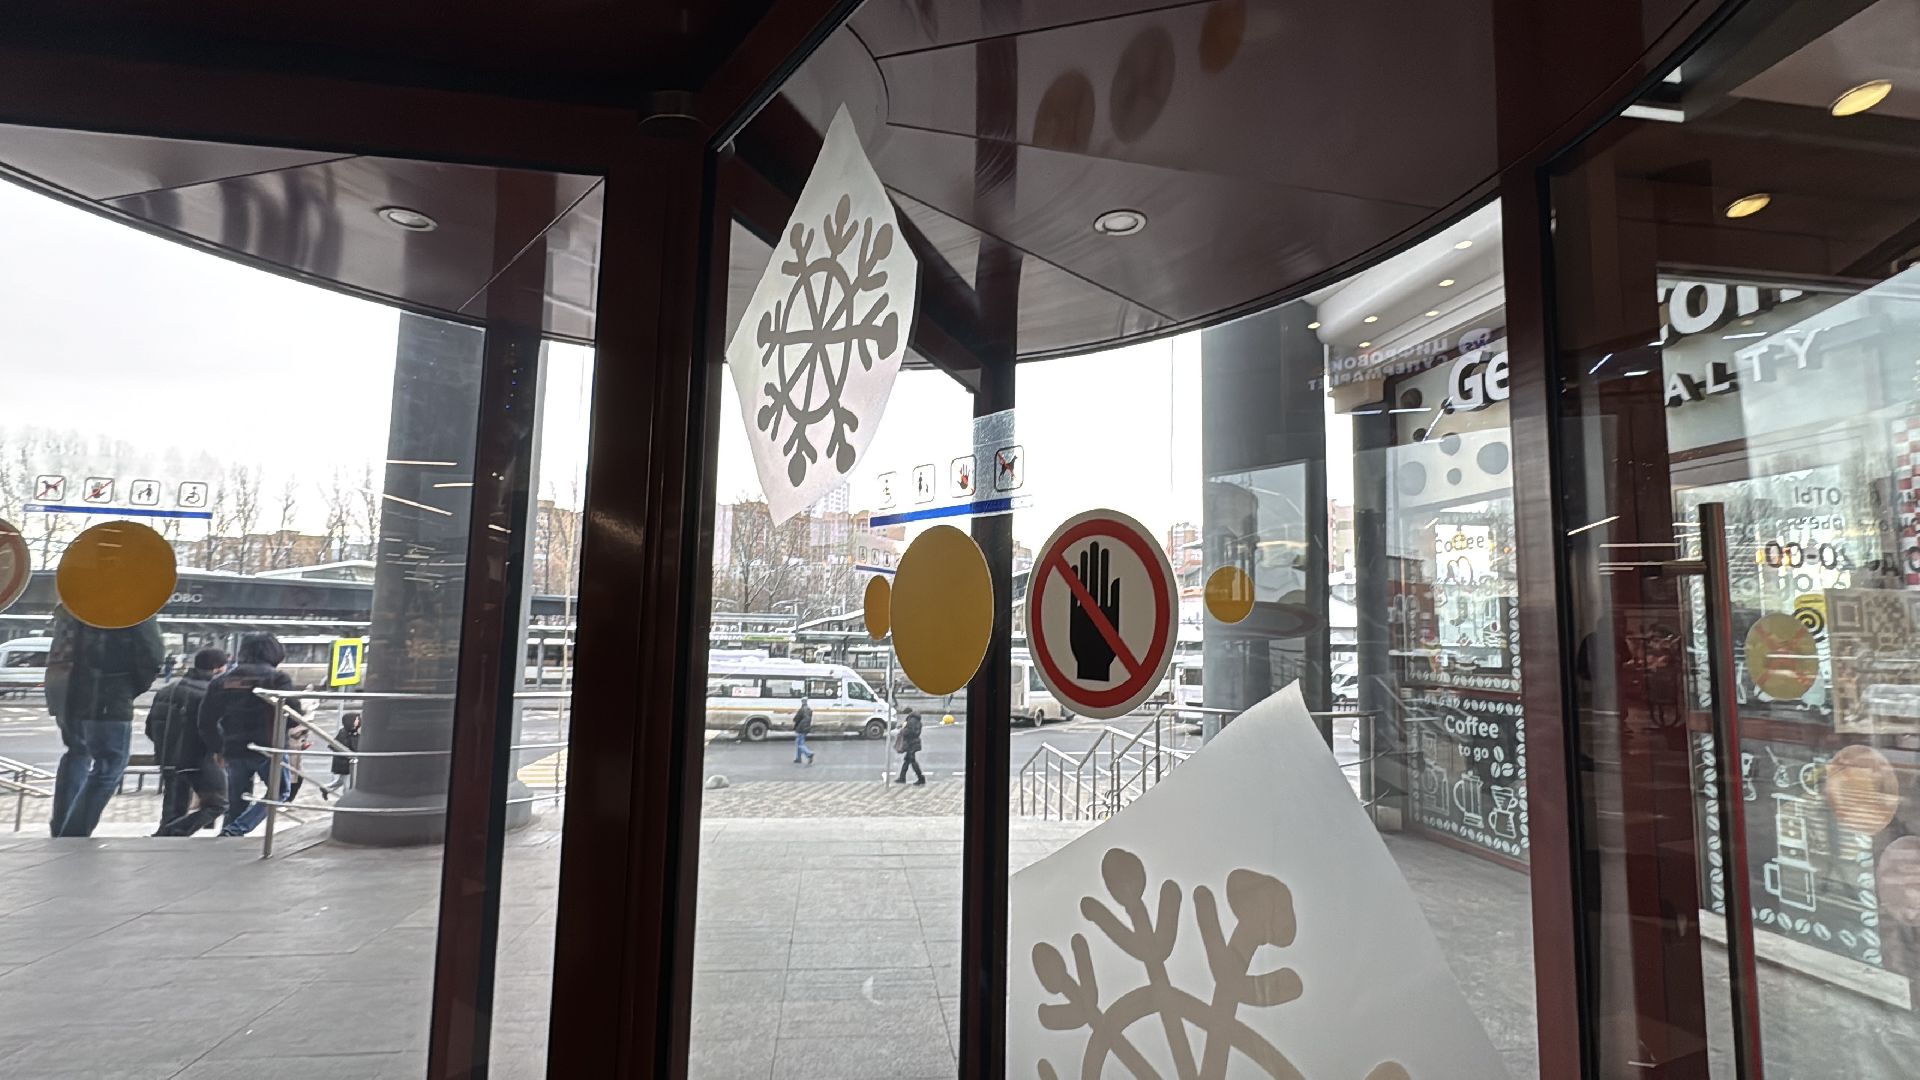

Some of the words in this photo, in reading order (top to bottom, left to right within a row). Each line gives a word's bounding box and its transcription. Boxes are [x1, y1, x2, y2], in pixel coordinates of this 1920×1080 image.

[171, 592, 203, 603] ОВО
[1444, 714, 1499, 739] Coffee
[1458, 743, 1471, 757] to
[1473, 746, 1490, 762] go
